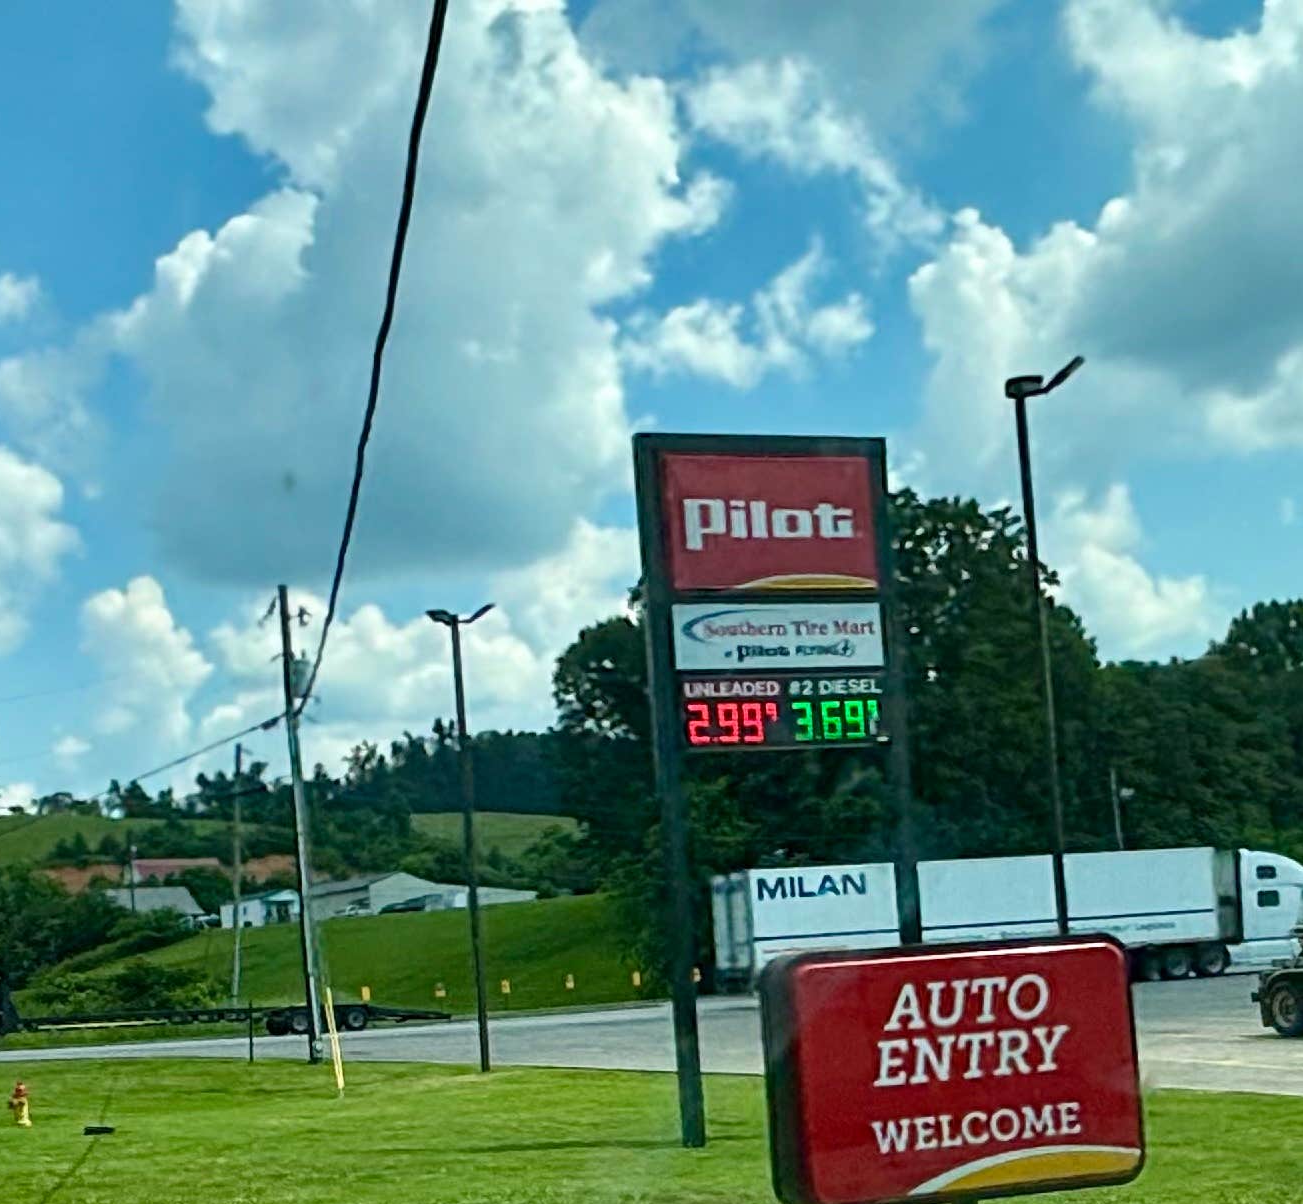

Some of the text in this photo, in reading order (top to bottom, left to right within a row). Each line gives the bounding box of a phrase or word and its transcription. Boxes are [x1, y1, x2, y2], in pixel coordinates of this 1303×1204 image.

[703, 619, 875, 638] Southern Tire Mart
[683, 680, 780, 697] UNLEADED
[817, 678, 882, 695] DIESEL
[757, 872, 867, 901] MILAN
[883, 974, 1050, 1032] AUTO
[873, 1024, 1071, 1088] ENTRY
[870, 1101, 1083, 1155] WELCOME
